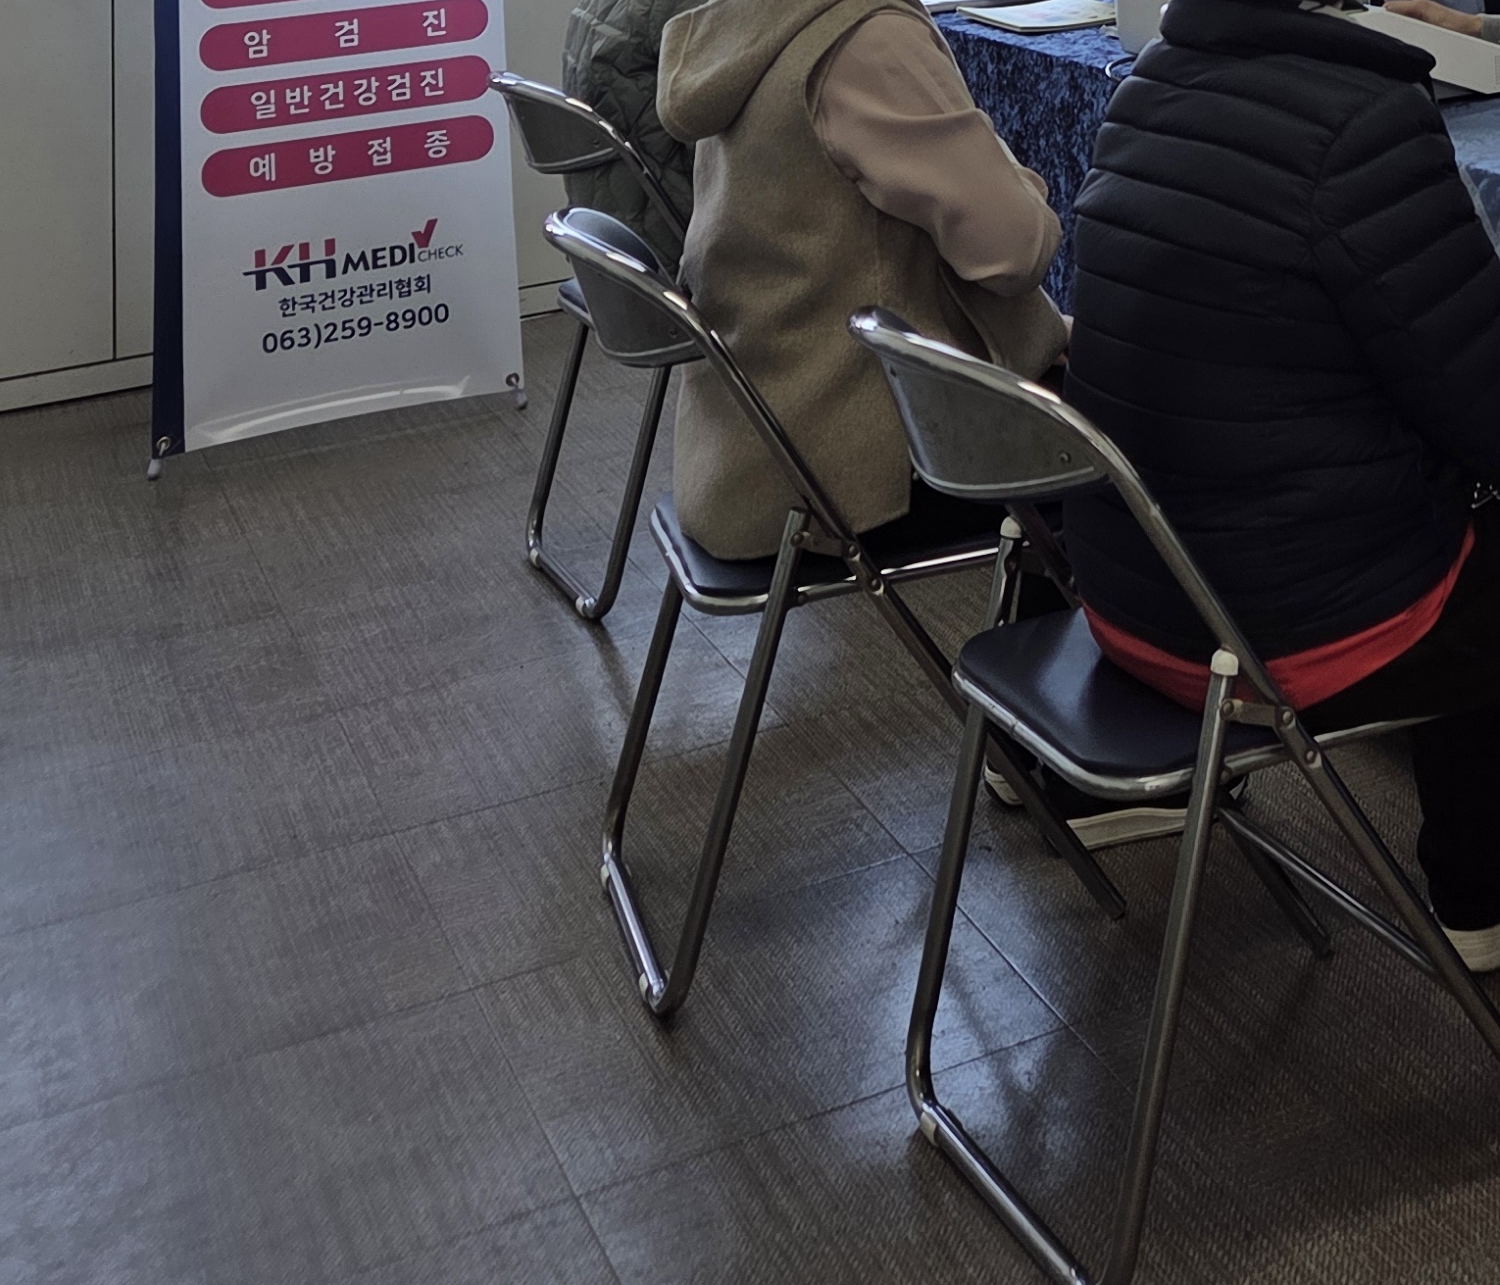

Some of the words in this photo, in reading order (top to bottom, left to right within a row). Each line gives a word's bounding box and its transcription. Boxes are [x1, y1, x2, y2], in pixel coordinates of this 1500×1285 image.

[250, 67, 445, 120] 일반건강검진
[242, 238, 337, 291] KH
[278, 274, 432, 318] 한국건강관리협회
[261, 302, 450, 354] 063)259-8900
